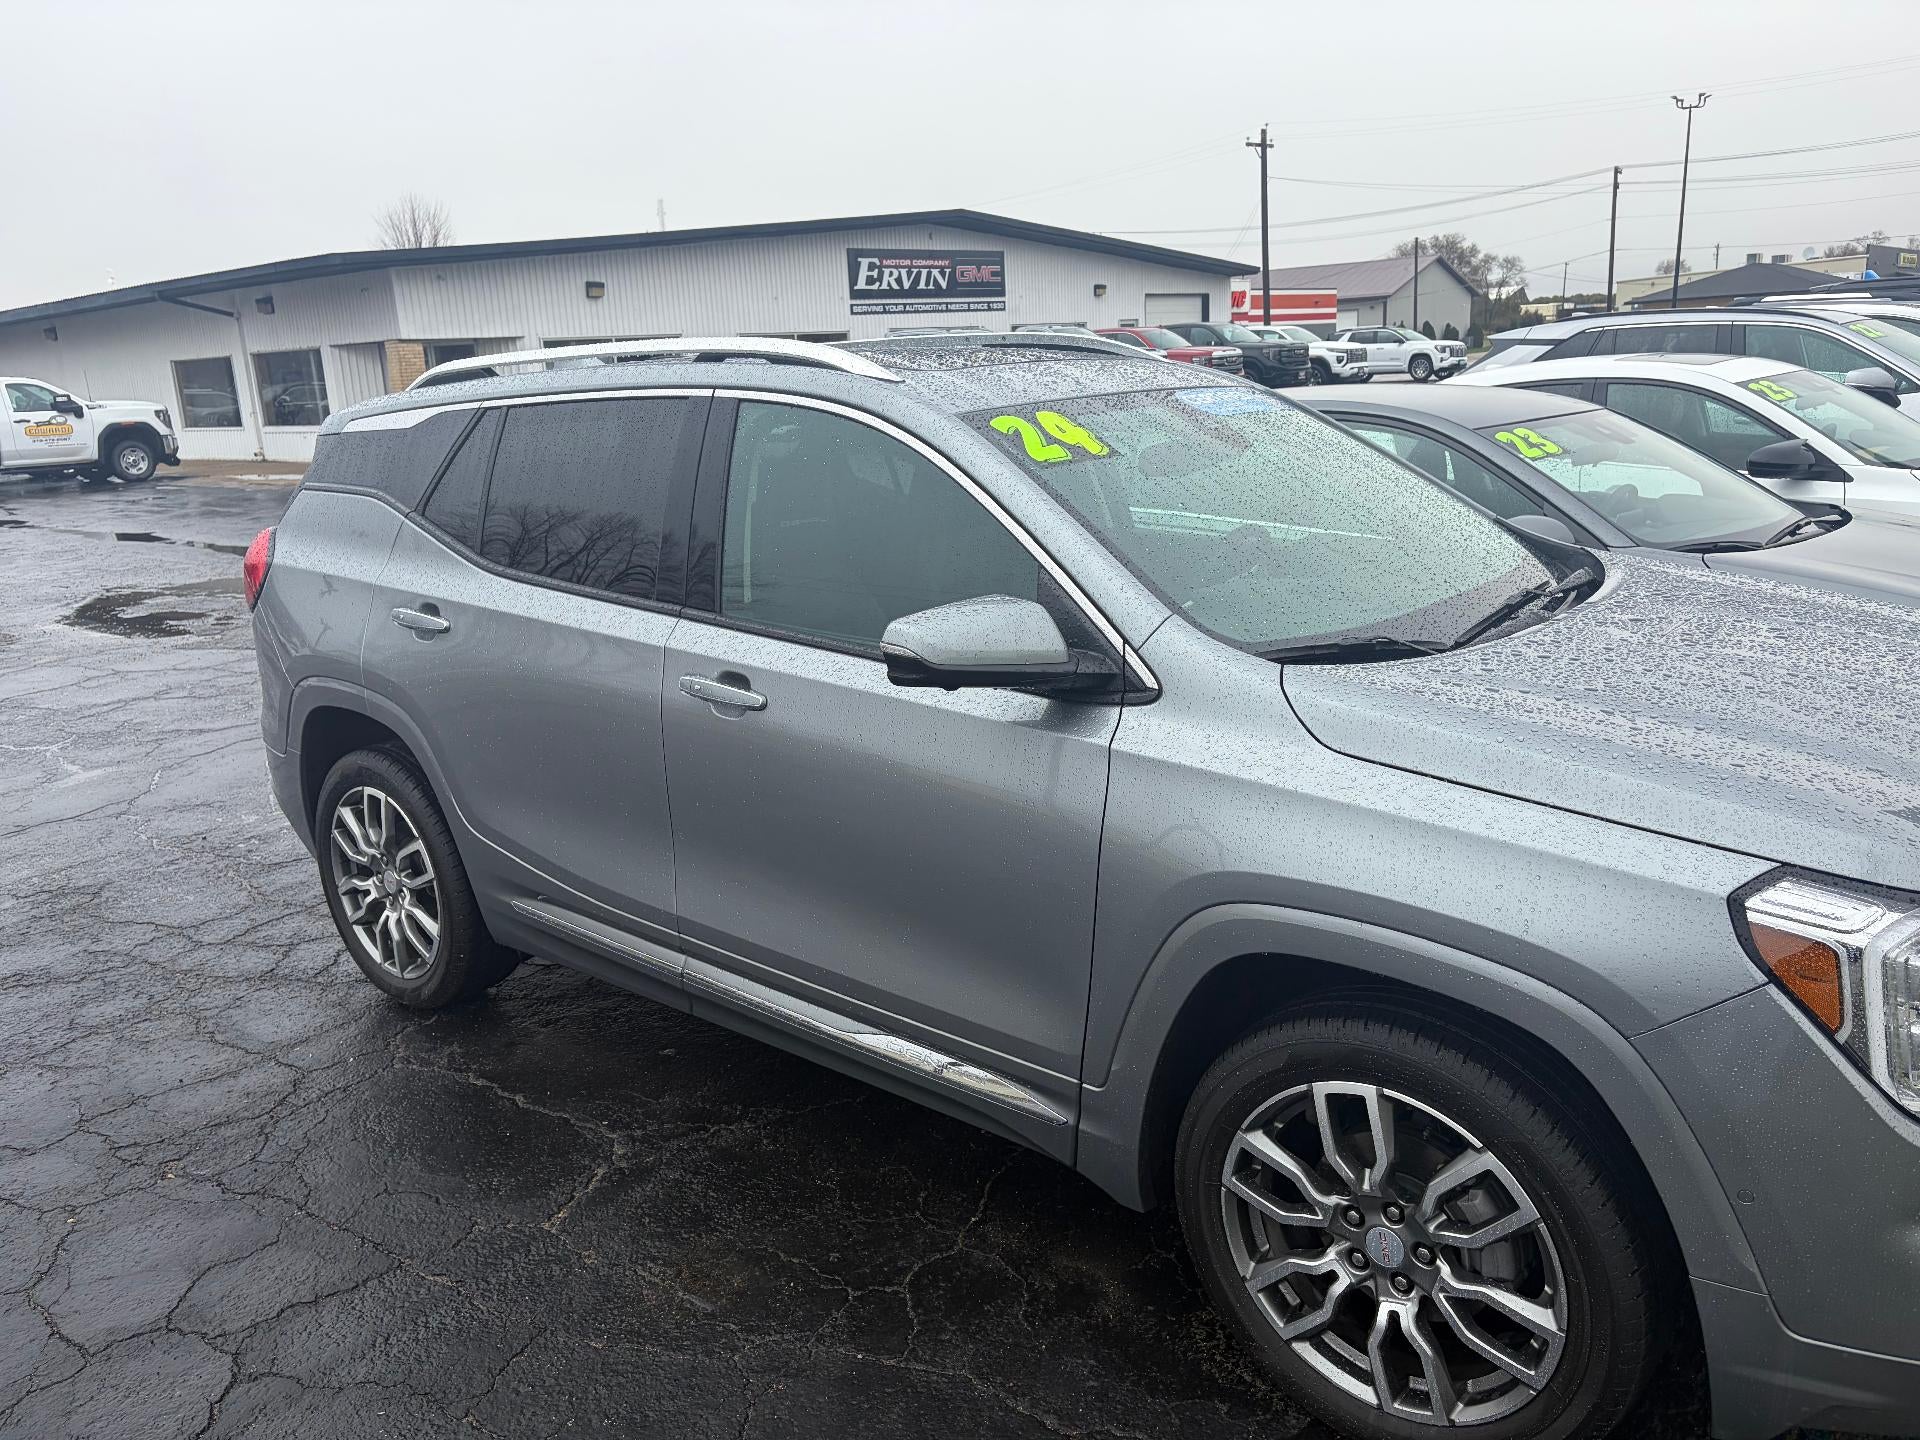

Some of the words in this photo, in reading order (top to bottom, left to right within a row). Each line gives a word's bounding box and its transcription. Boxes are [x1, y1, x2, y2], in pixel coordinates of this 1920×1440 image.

[854, 257, 951, 290] ERVIN
[956, 265, 1001, 282] GMC
[852, 304, 883, 312] SERVING
[885, 304, 905, 312] YOUR
[905, 303, 947, 311] AUTOMOTIVE
[969, 302, 989, 310] SINCE
[1747, 380, 1798, 401] 23
[989, 411, 1110, 462] 24
[1494, 427, 1564, 460] 23
[1378, 1231, 1391, 1265] GMC
